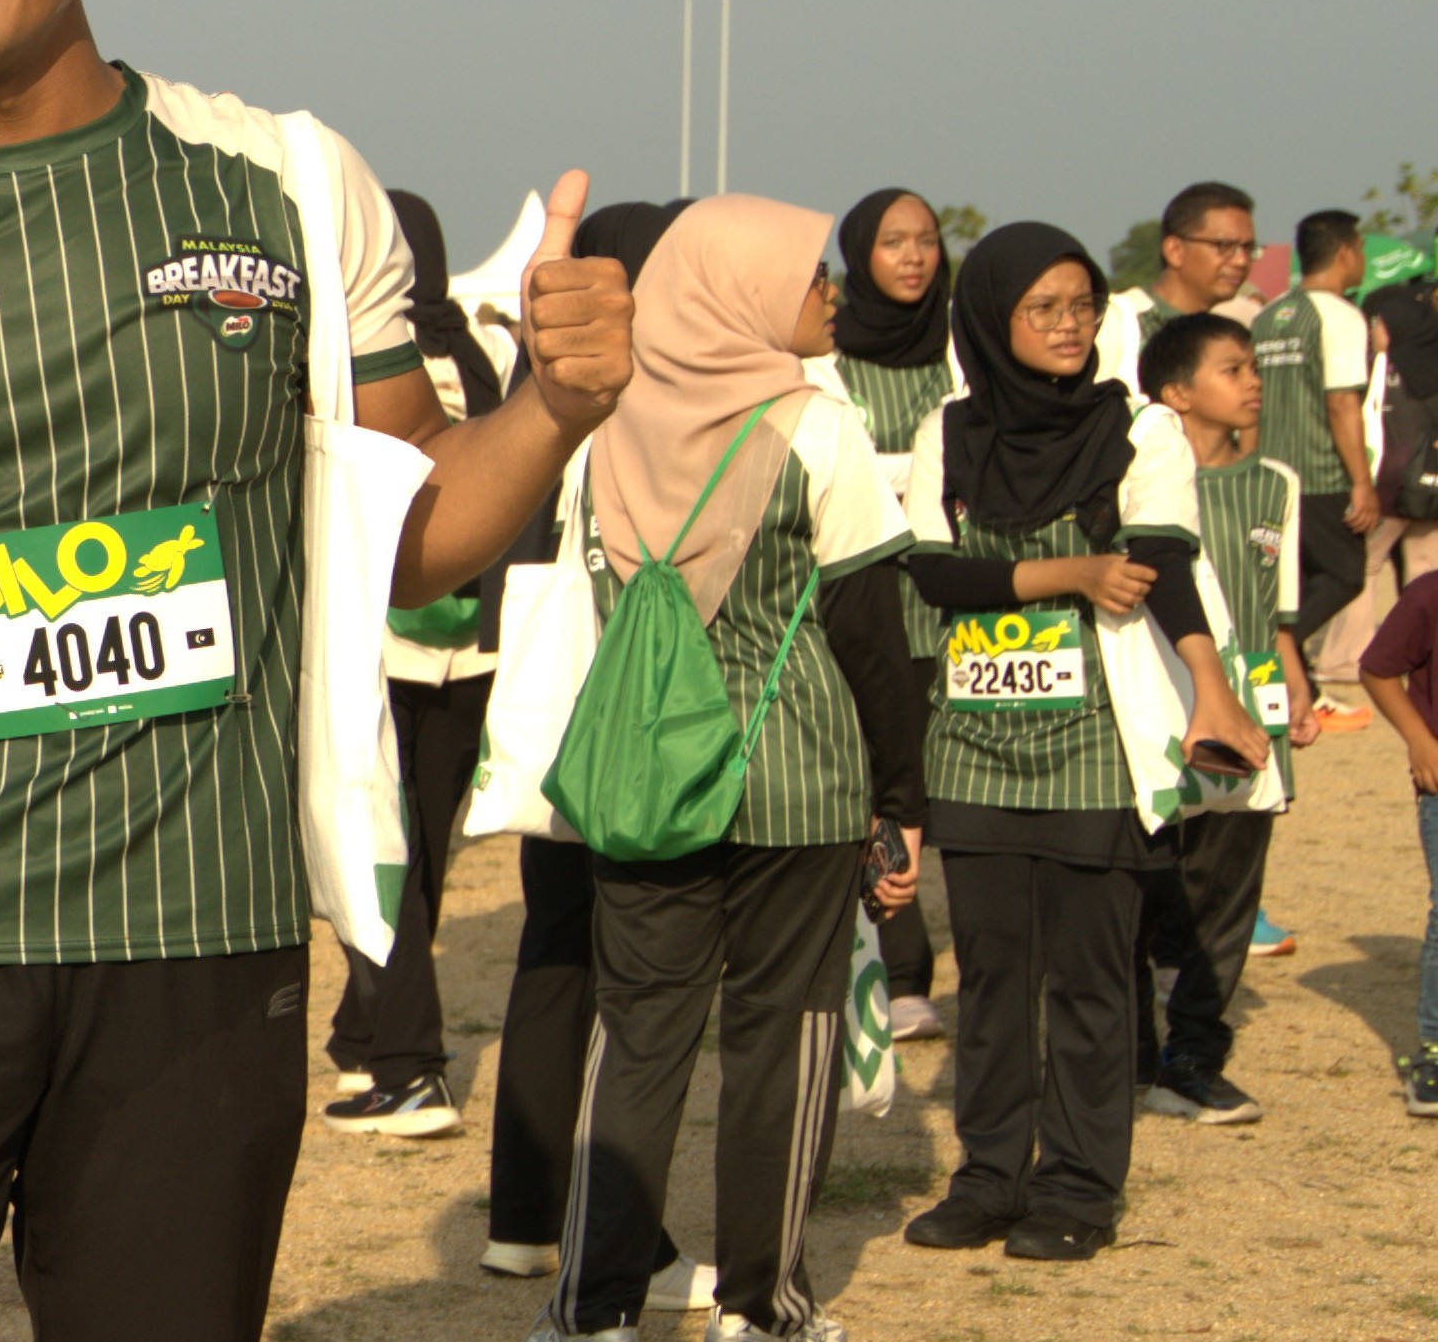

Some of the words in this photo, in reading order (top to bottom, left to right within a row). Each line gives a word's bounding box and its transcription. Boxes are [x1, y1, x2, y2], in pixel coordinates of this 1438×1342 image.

[181, 239, 262, 254] MALAYSIA
[147, 254, 301, 299] BREAKFAST
[162, 294, 190, 306] DAY
[23, 611, 165, 697] 4040
[948, 613, 1030, 667] MILO
[969, 660, 1053, 695] 2243C
